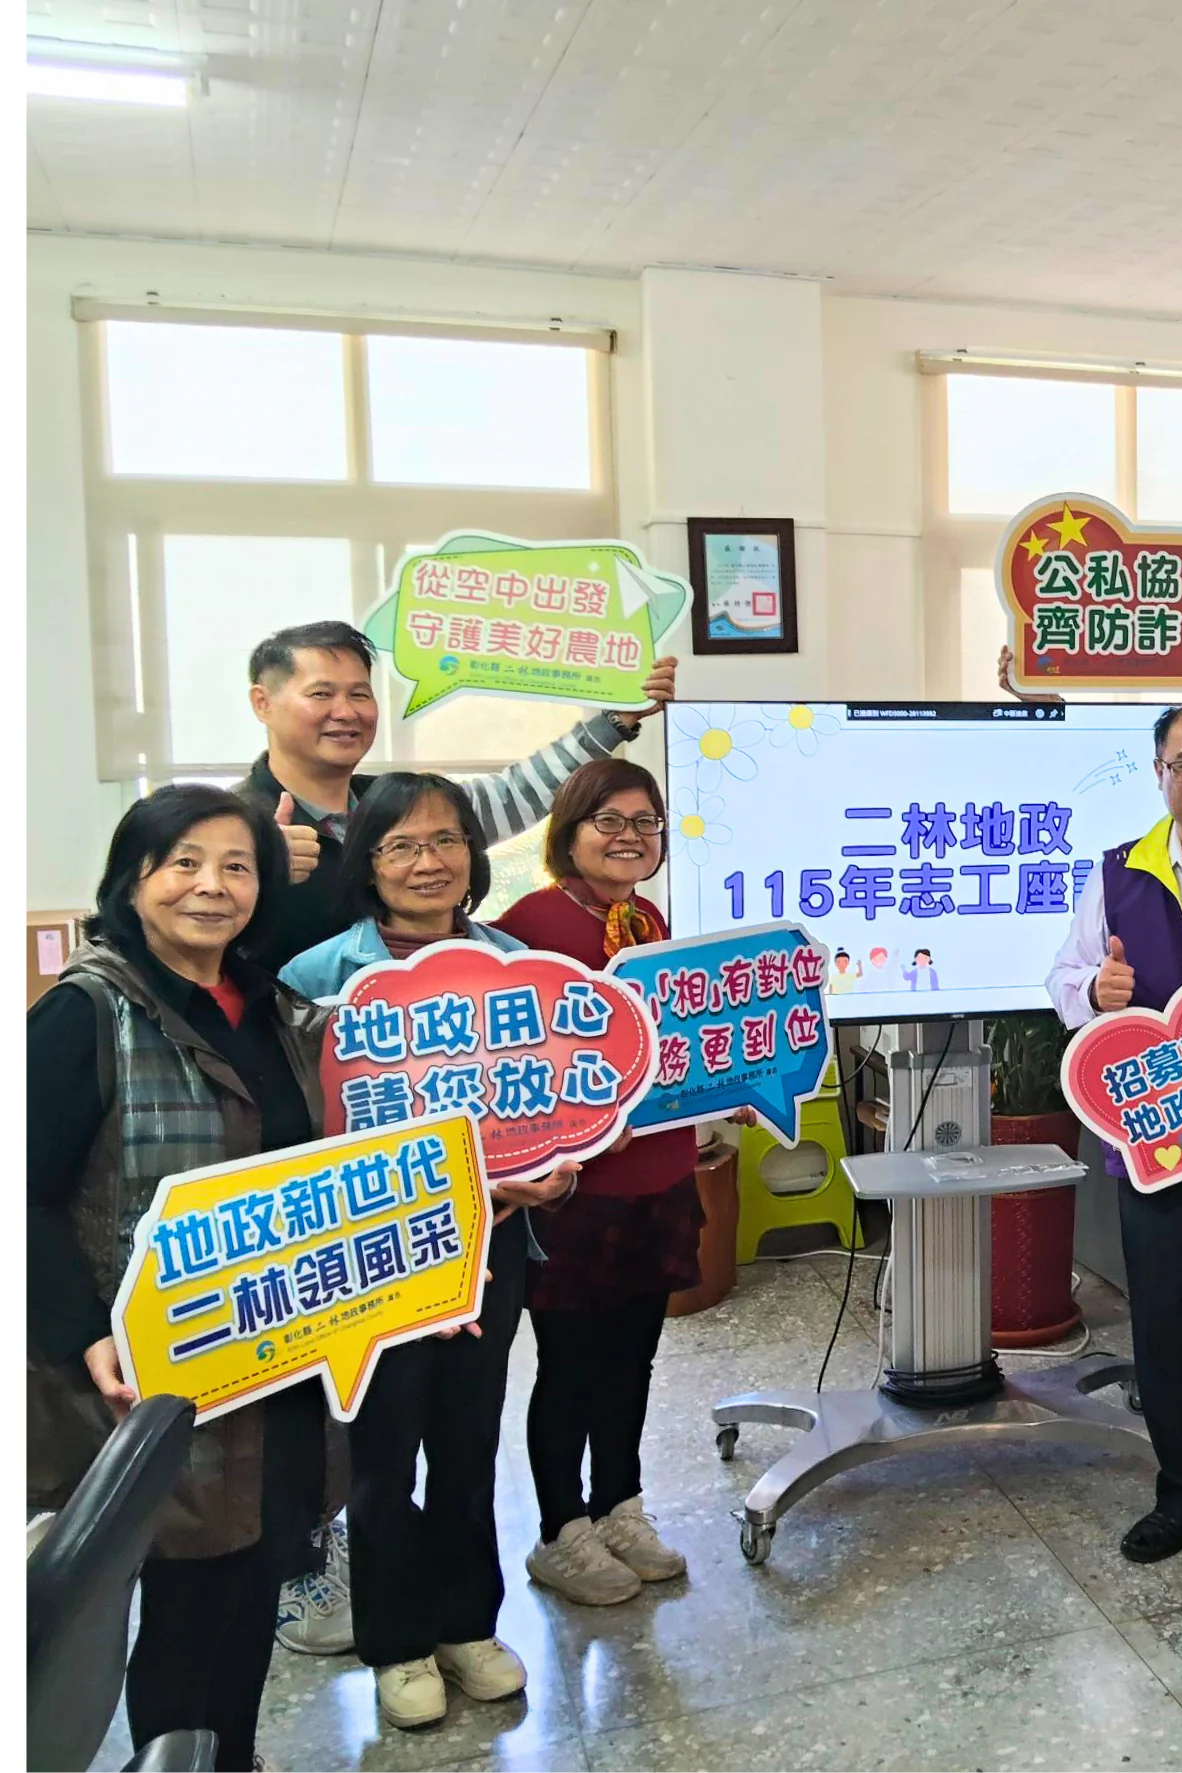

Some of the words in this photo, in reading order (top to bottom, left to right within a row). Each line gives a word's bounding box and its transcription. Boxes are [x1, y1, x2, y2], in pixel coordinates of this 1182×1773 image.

[416, 563, 609, 616] 從空中出發
[408, 613, 640, 668] 守護美好農地
[1037, 606, 1178, 651] 齊防詐
[842, 801, 1072, 859] 二林地政
[338, 986, 609, 1058] 地政用心
[346, 1055, 617, 1132] 請您放心
[153, 1138, 448, 1284] 地政新世代
[171, 1202, 458, 1356] 二林領風采
